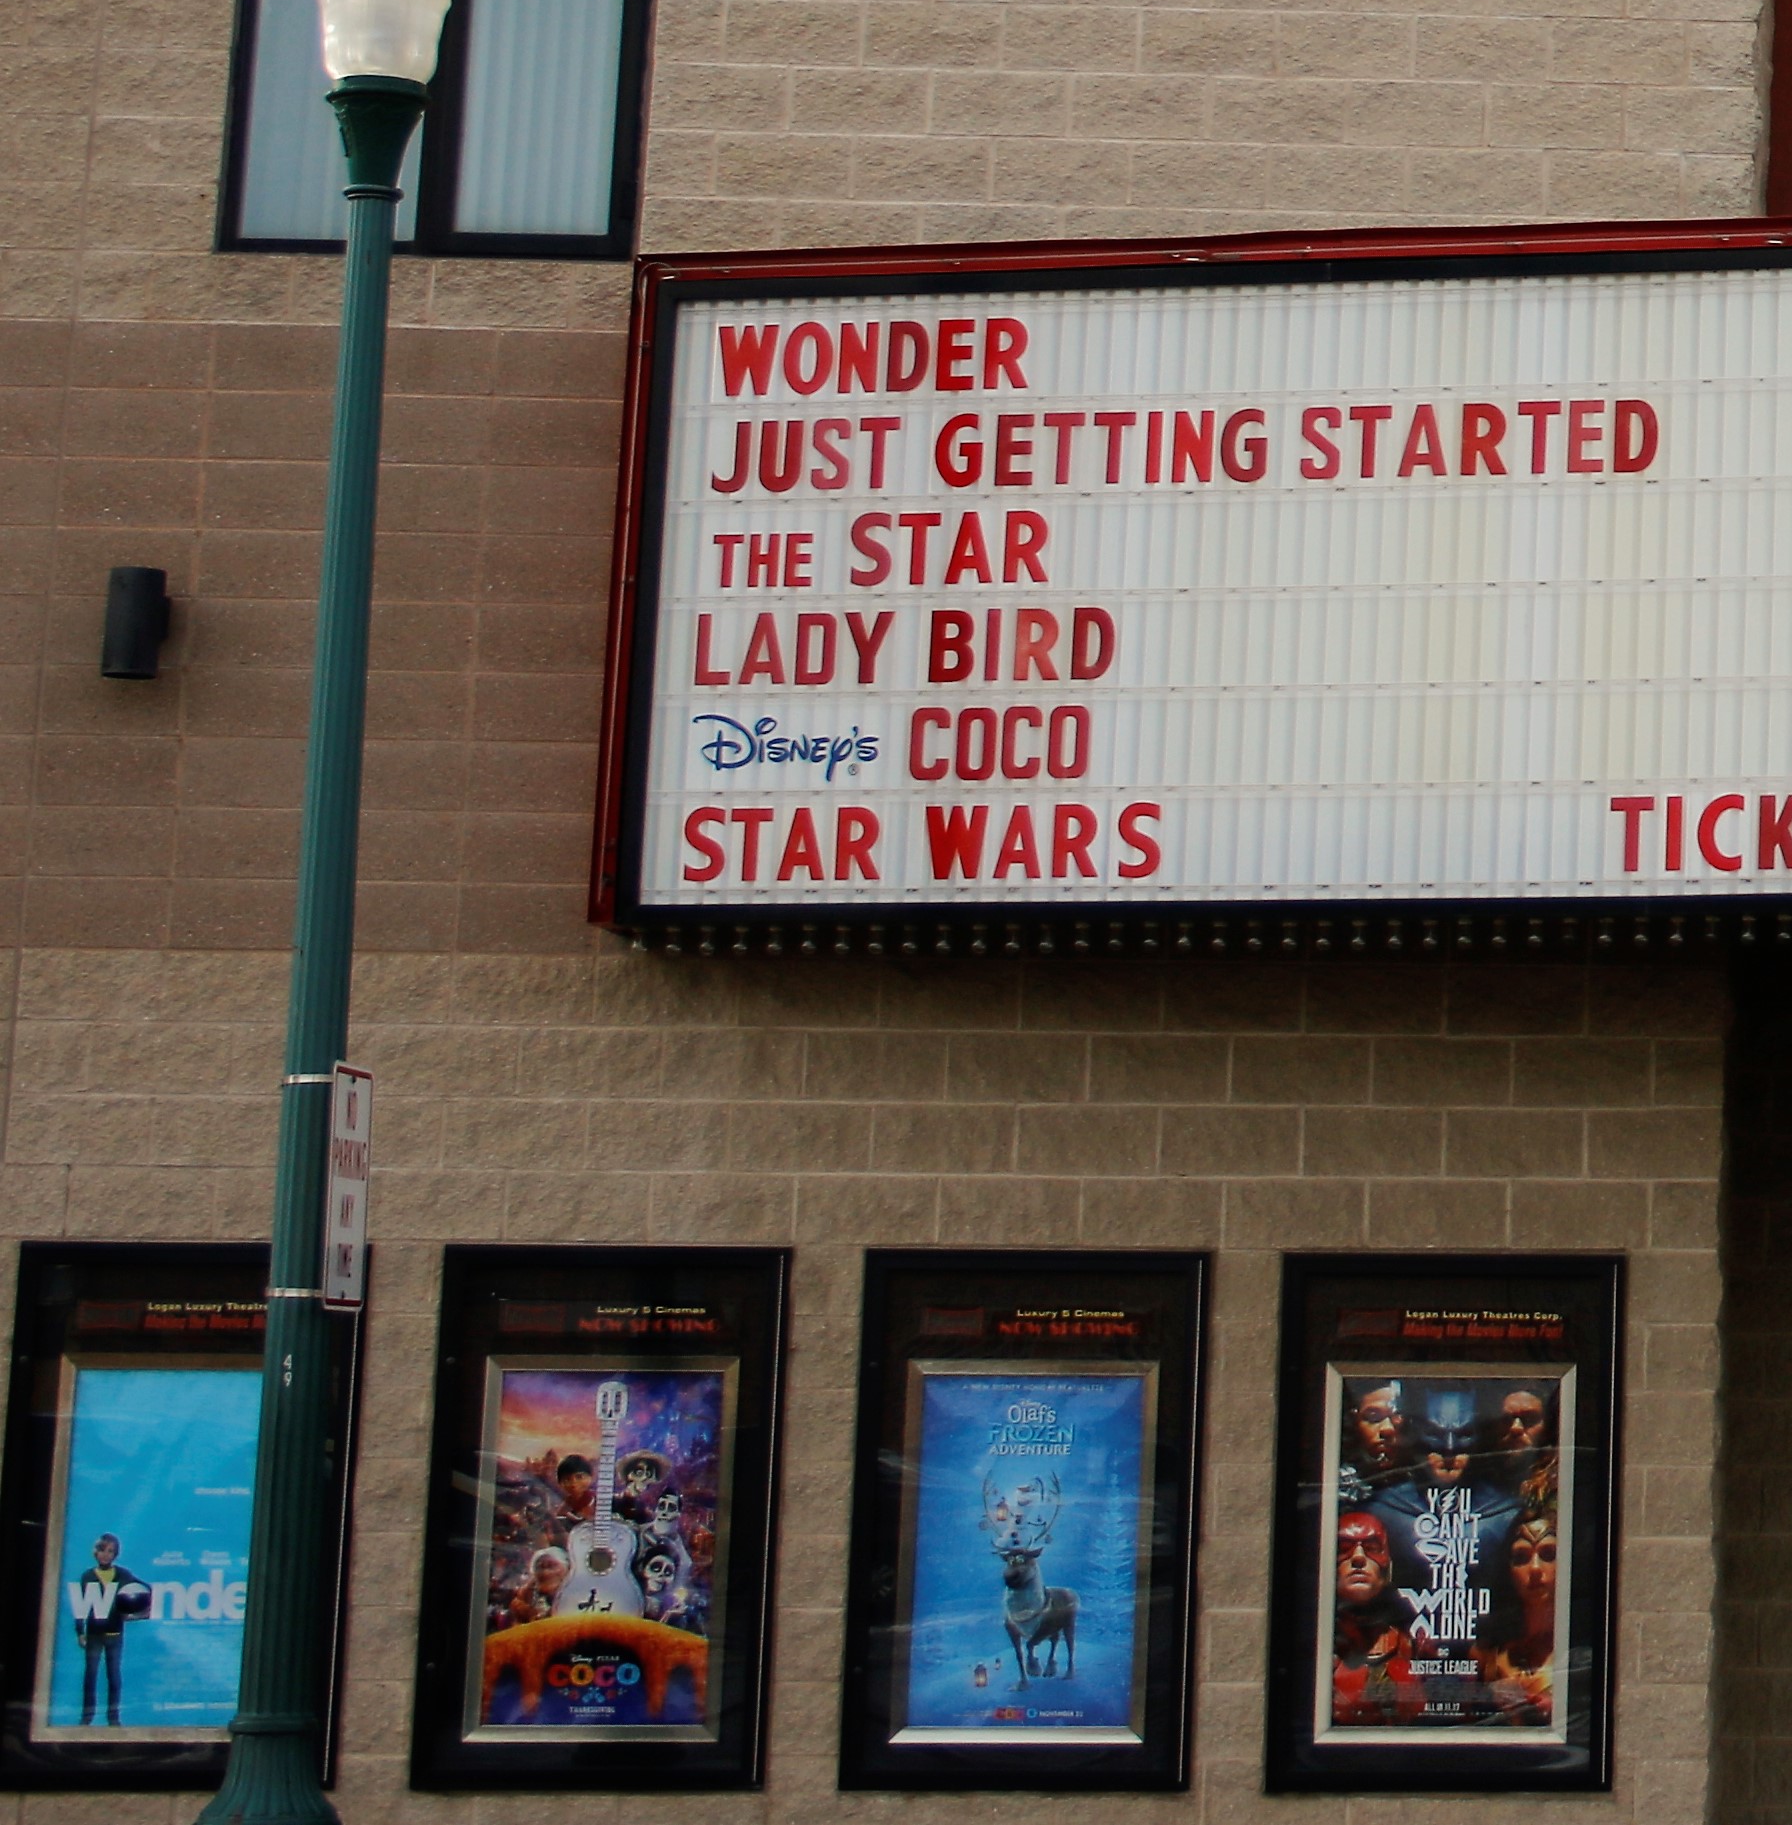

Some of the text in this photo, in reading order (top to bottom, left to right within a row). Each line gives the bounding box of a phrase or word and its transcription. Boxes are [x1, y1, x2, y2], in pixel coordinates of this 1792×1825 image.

[720, 318, 1028, 397] WONDER
[713, 400, 1659, 493] JUST GETTING STARTED
[714, 510, 1049, 587] THE STAR
[696, 607, 1116, 686] LADY BIRD
[910, 705, 1091, 781] COCO
[684, 802, 1162, 883] STAR WARS
[148, 1302, 268, 1313] Logan Luxury Theatre
[597, 1306, 638, 1315] Luxury
[1017, 1309, 1057, 1318] Luxury
[1406, 1310, 1563, 1321] Logan Luxury Theatres Corp.
[1008, 1404, 1056, 1424] Olaf's
[988, 1423, 1074, 1444] FROZEN
[989, 1444, 1071, 1456] ADVENTURE
[1428, 1486, 1471, 1515] YOU
[1414, 1513, 1481, 1538] CAN'T
[1415, 1538, 1480, 1564] SAVE
[1398, 1588, 1490, 1614] WORLD
[1409, 1613, 1477, 1639] ALONE
[547, 1663, 641, 1687] COCO
[1408, 1660, 1478, 1674] JUSTICE LEAGUE
